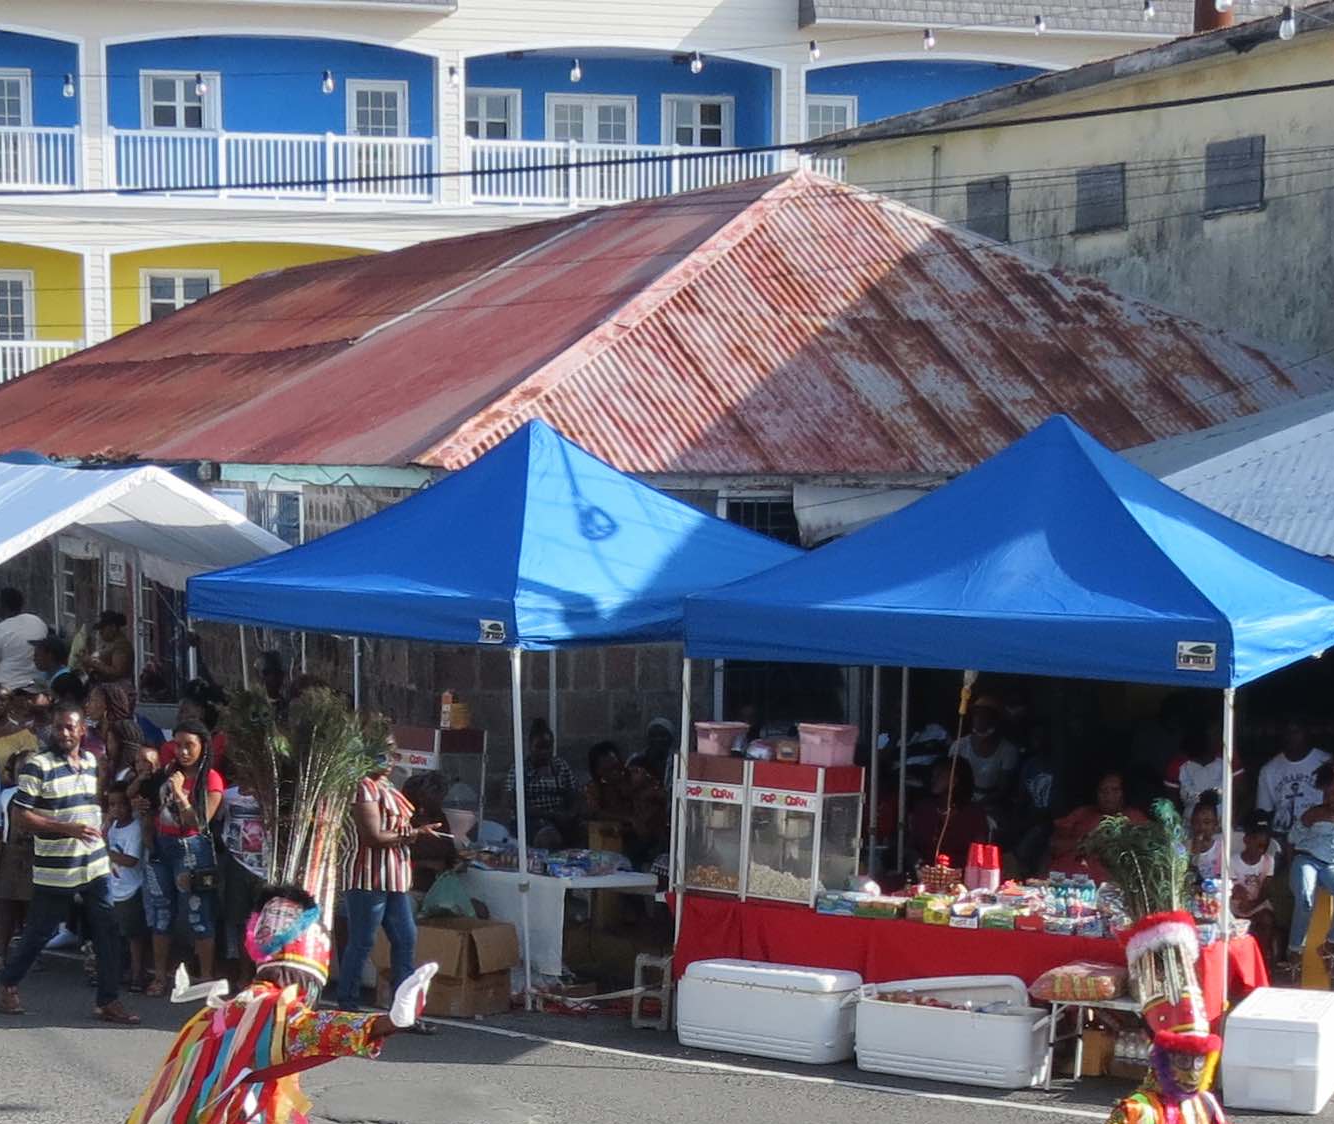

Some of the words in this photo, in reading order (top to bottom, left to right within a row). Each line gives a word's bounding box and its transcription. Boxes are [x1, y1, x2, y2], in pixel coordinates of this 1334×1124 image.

[686, 786, 702, 796] POP
[710, 788, 735, 801] CORN
[760, 793, 777, 803] POP
[786, 795, 808, 808] CORN
